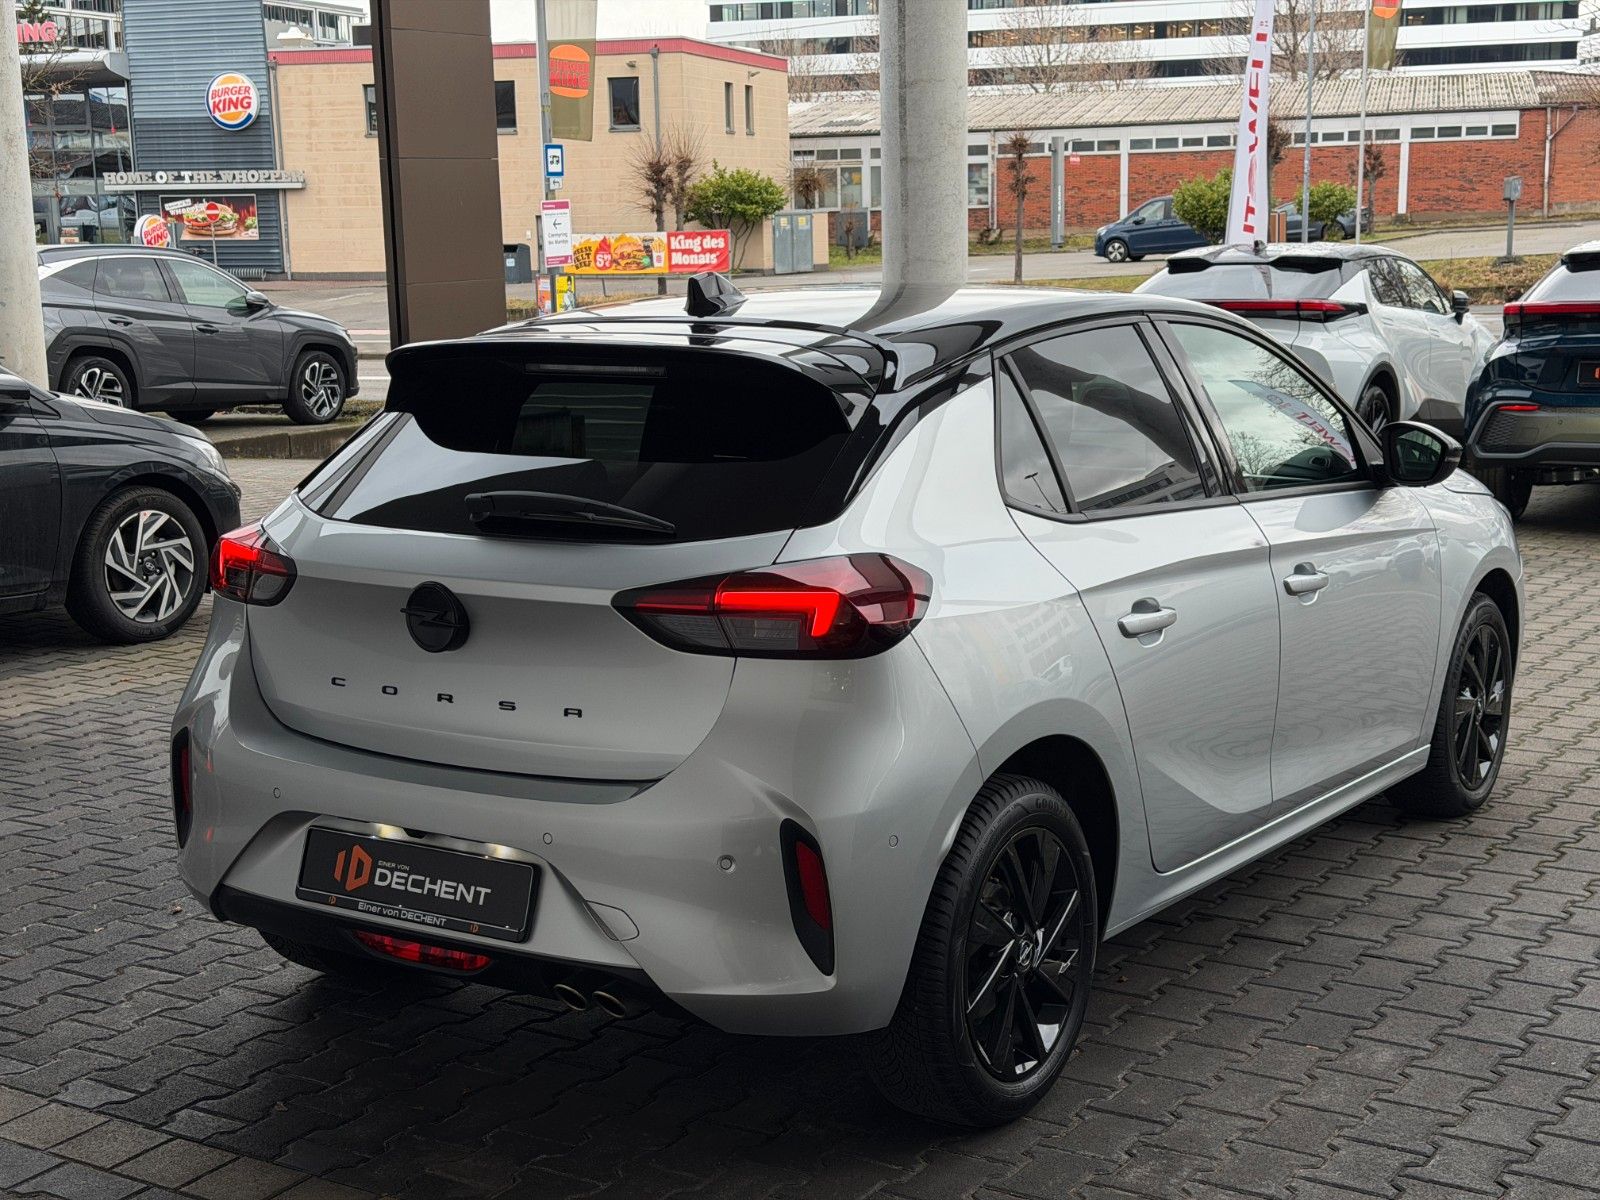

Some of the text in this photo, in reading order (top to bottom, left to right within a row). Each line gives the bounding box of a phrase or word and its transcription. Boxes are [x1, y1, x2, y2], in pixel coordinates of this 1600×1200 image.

[549, 71, 590, 89] KING
[211, 86, 251, 100] BURGER
[212, 96, 252, 114] KING
[103, 170, 304, 184] HOME OF THE WHOPPER
[146, 229, 168, 246] KING
[670, 235, 725, 252] King des
[331, 676, 582, 718] CORSA
[378, 860, 410, 871] EINER VON
[374, 868, 492, 906] DECHENT
[382, 907, 400, 917] von
[400, 910, 447, 927] DECHENT
